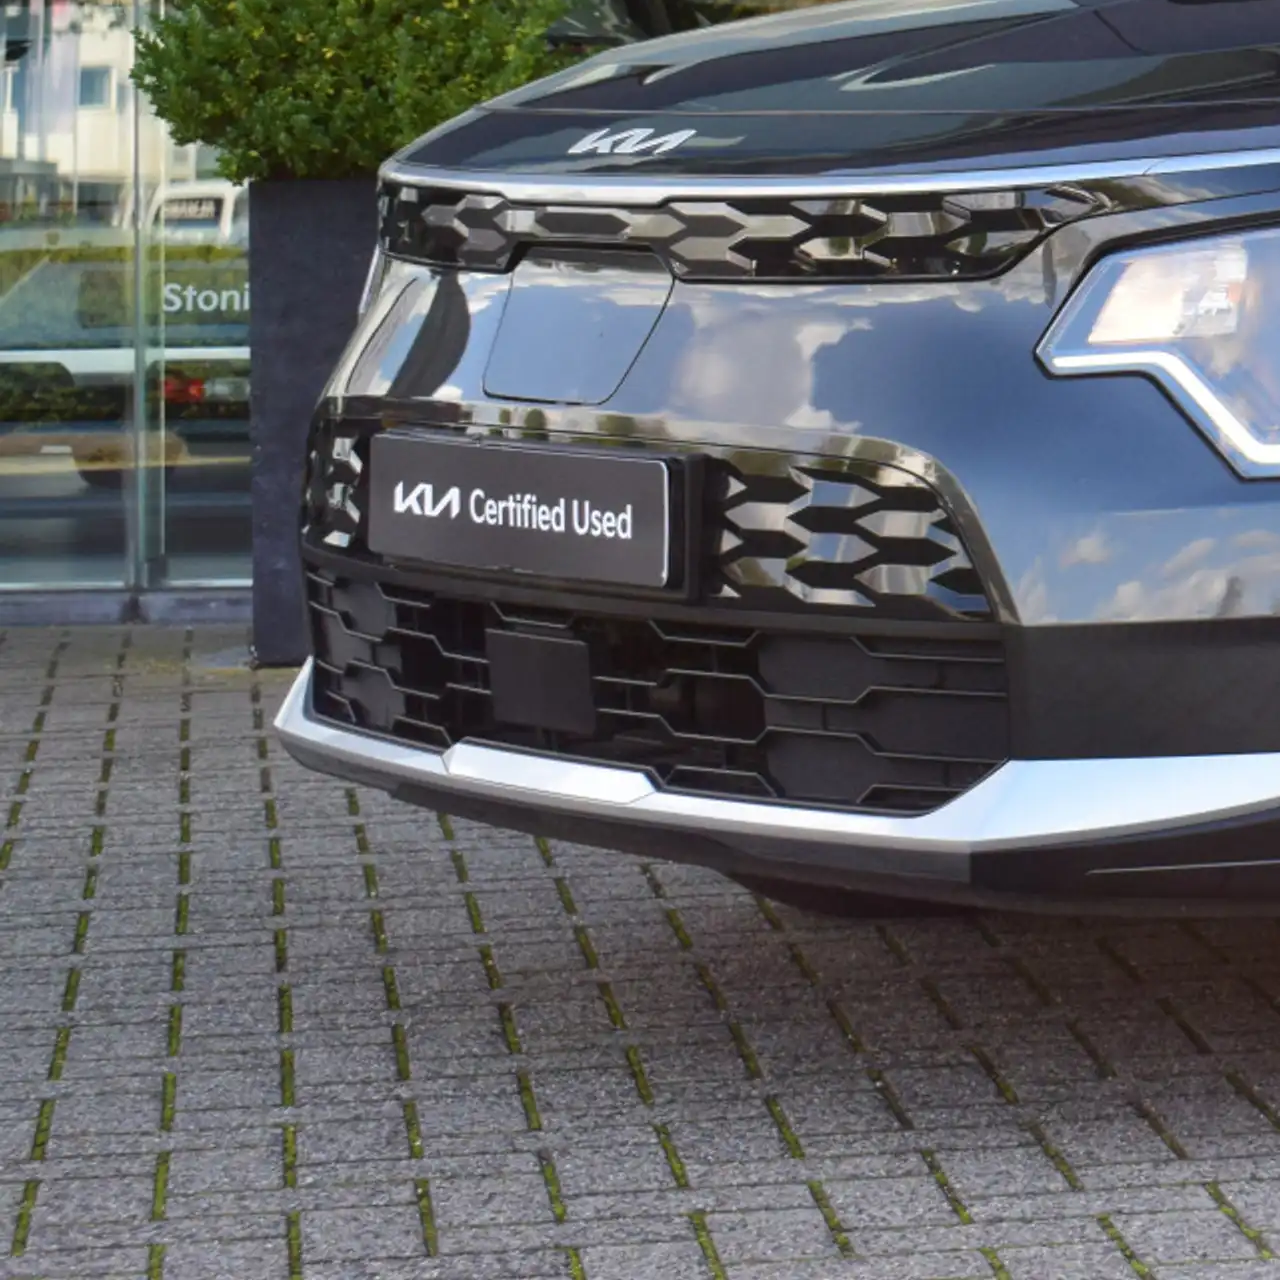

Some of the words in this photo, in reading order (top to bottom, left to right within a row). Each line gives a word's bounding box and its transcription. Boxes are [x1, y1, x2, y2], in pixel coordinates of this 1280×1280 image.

[567, 128, 698, 155] KIA
[393, 481, 461, 519] KIA
[469, 488, 566, 532] Certified
[572, 499, 633, 539] Used
